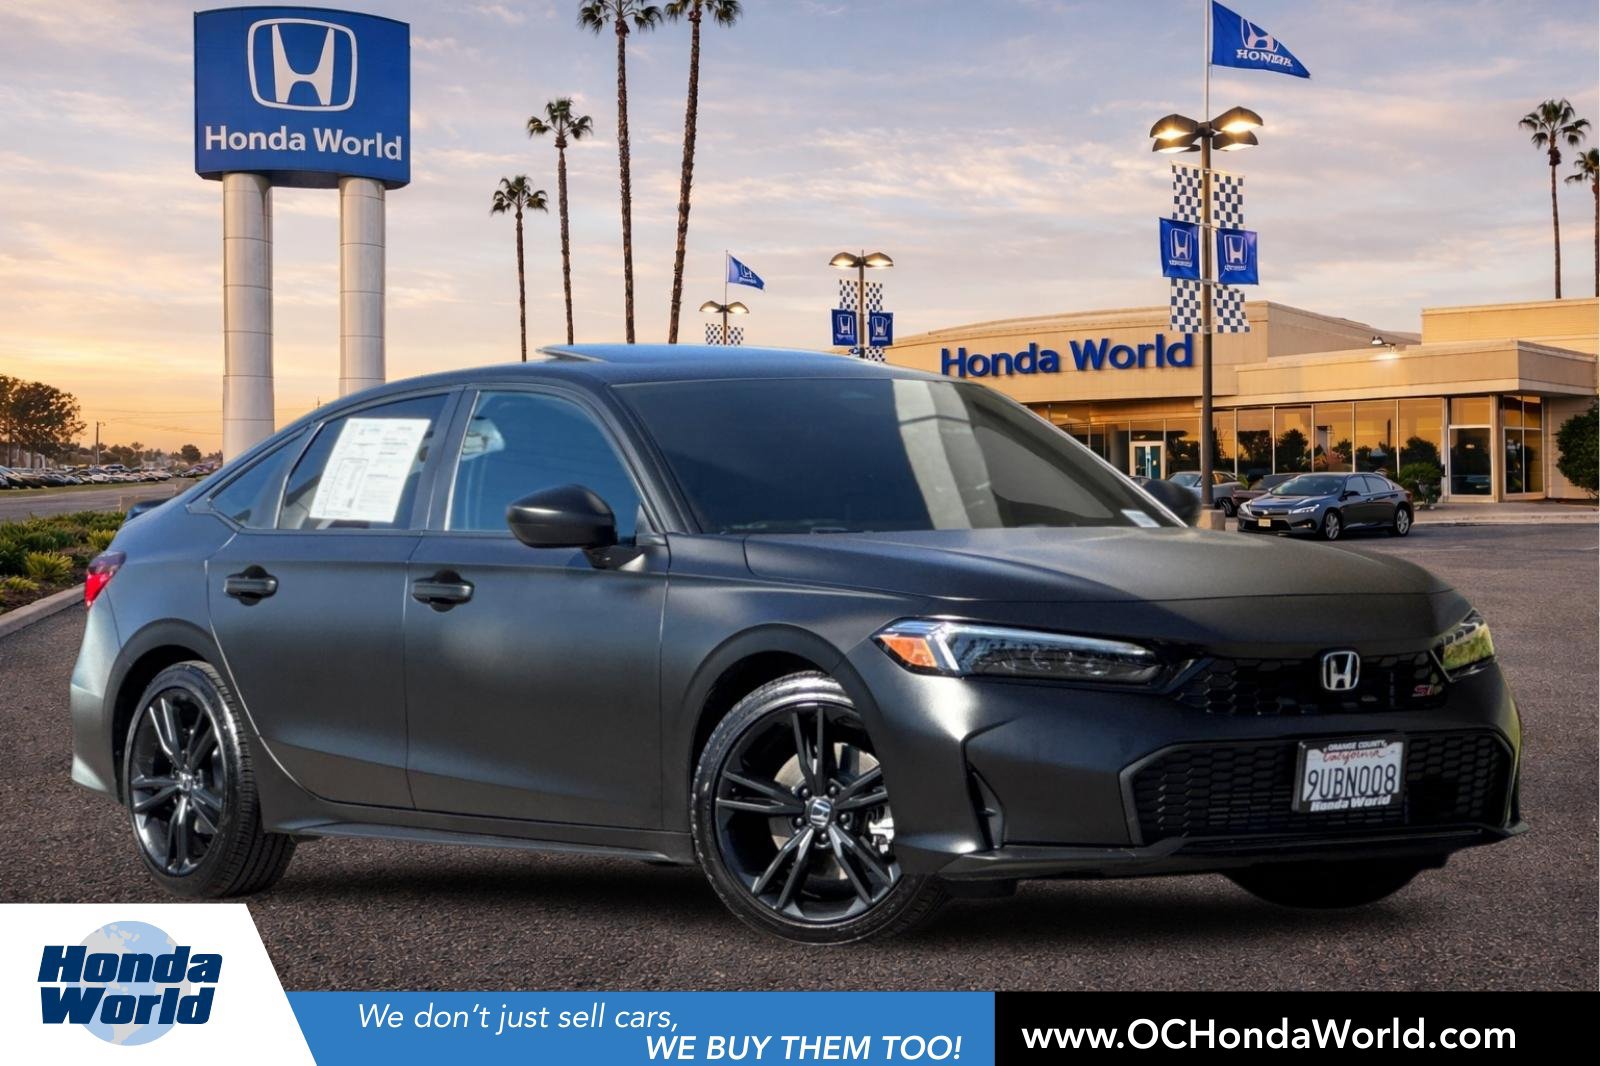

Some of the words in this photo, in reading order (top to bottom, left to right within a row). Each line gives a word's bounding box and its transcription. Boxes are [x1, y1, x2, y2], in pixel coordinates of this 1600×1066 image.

[205, 125, 306, 151] Honda
[312, 127, 402, 161] World
[941, 342, 1060, 378] Honda
[1069, 333, 1194, 371] World
[1328, 742, 1357, 751] ORANGE
[1306, 764, 1397, 801] 9UBN008
[1310, 800, 1349, 812] Honda
[1350, 794, 1392, 808] World
